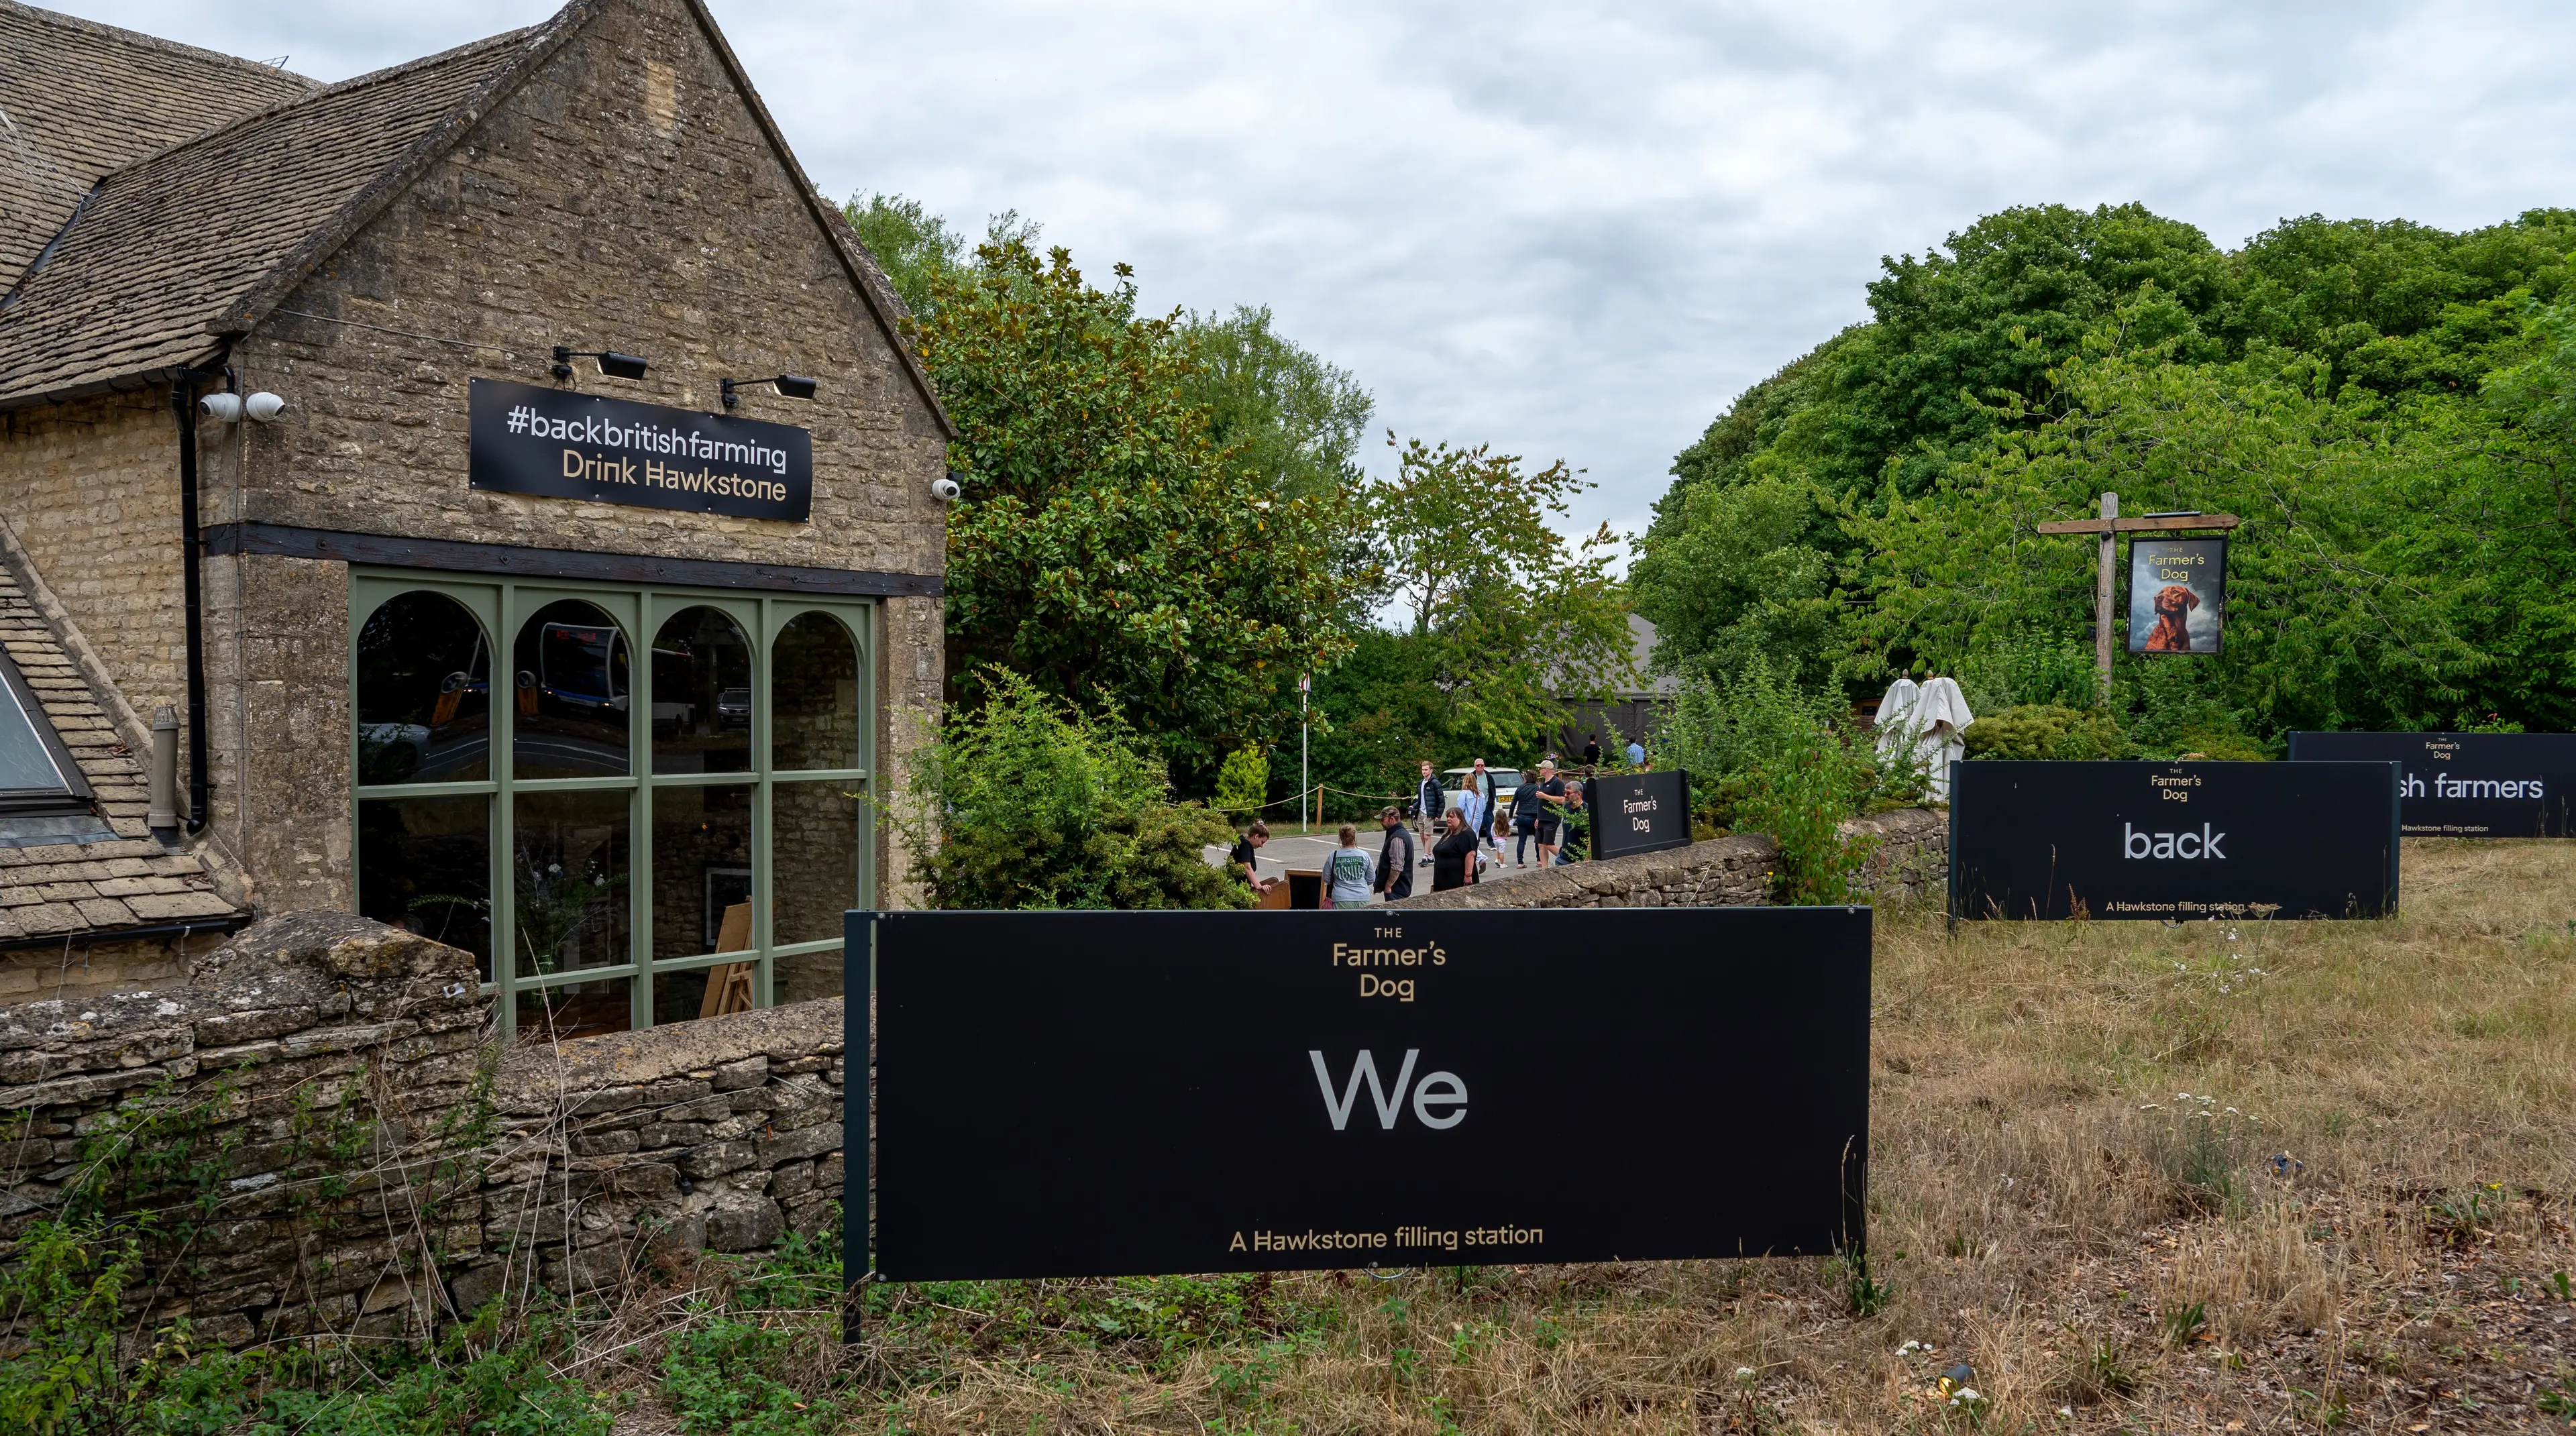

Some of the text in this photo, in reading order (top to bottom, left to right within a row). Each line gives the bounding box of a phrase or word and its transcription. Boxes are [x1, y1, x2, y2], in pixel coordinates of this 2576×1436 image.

[507, 405, 786, 475] #backbritishfarming
[564, 449, 786, 502] Drink Hawkstone
[2149, 553, 2204, 565] Farmer's
[2161, 568, 2188, 582] Dog
[2426, 742, 2460, 750] Farmer's
[2434, 751, 2451, 760] Dog
[2151, 775, 2201, 786] Farmer's
[2434, 773, 2543, 799] farmers
[2163, 789, 2188, 802] Dog
[1623, 795, 1657, 814] Farmer's
[1633, 817, 1650, 832] Dog
[2443, 824, 2463, 833] filling
[2125, 822, 2226, 859] back
[2106, 902, 2114, 912] A
[2116, 901, 2175, 912] Hawkstone
[2178, 901, 2206, 913] filling
[1374, 928, 1402, 938] THE
[1333, 940, 1446, 966] Farmer's
[1360, 974, 1415, 1002] Dog
[1308, 1048, 1468, 1131] We
[1229, 1224, 1543, 1252] A Hawkstone filling station
